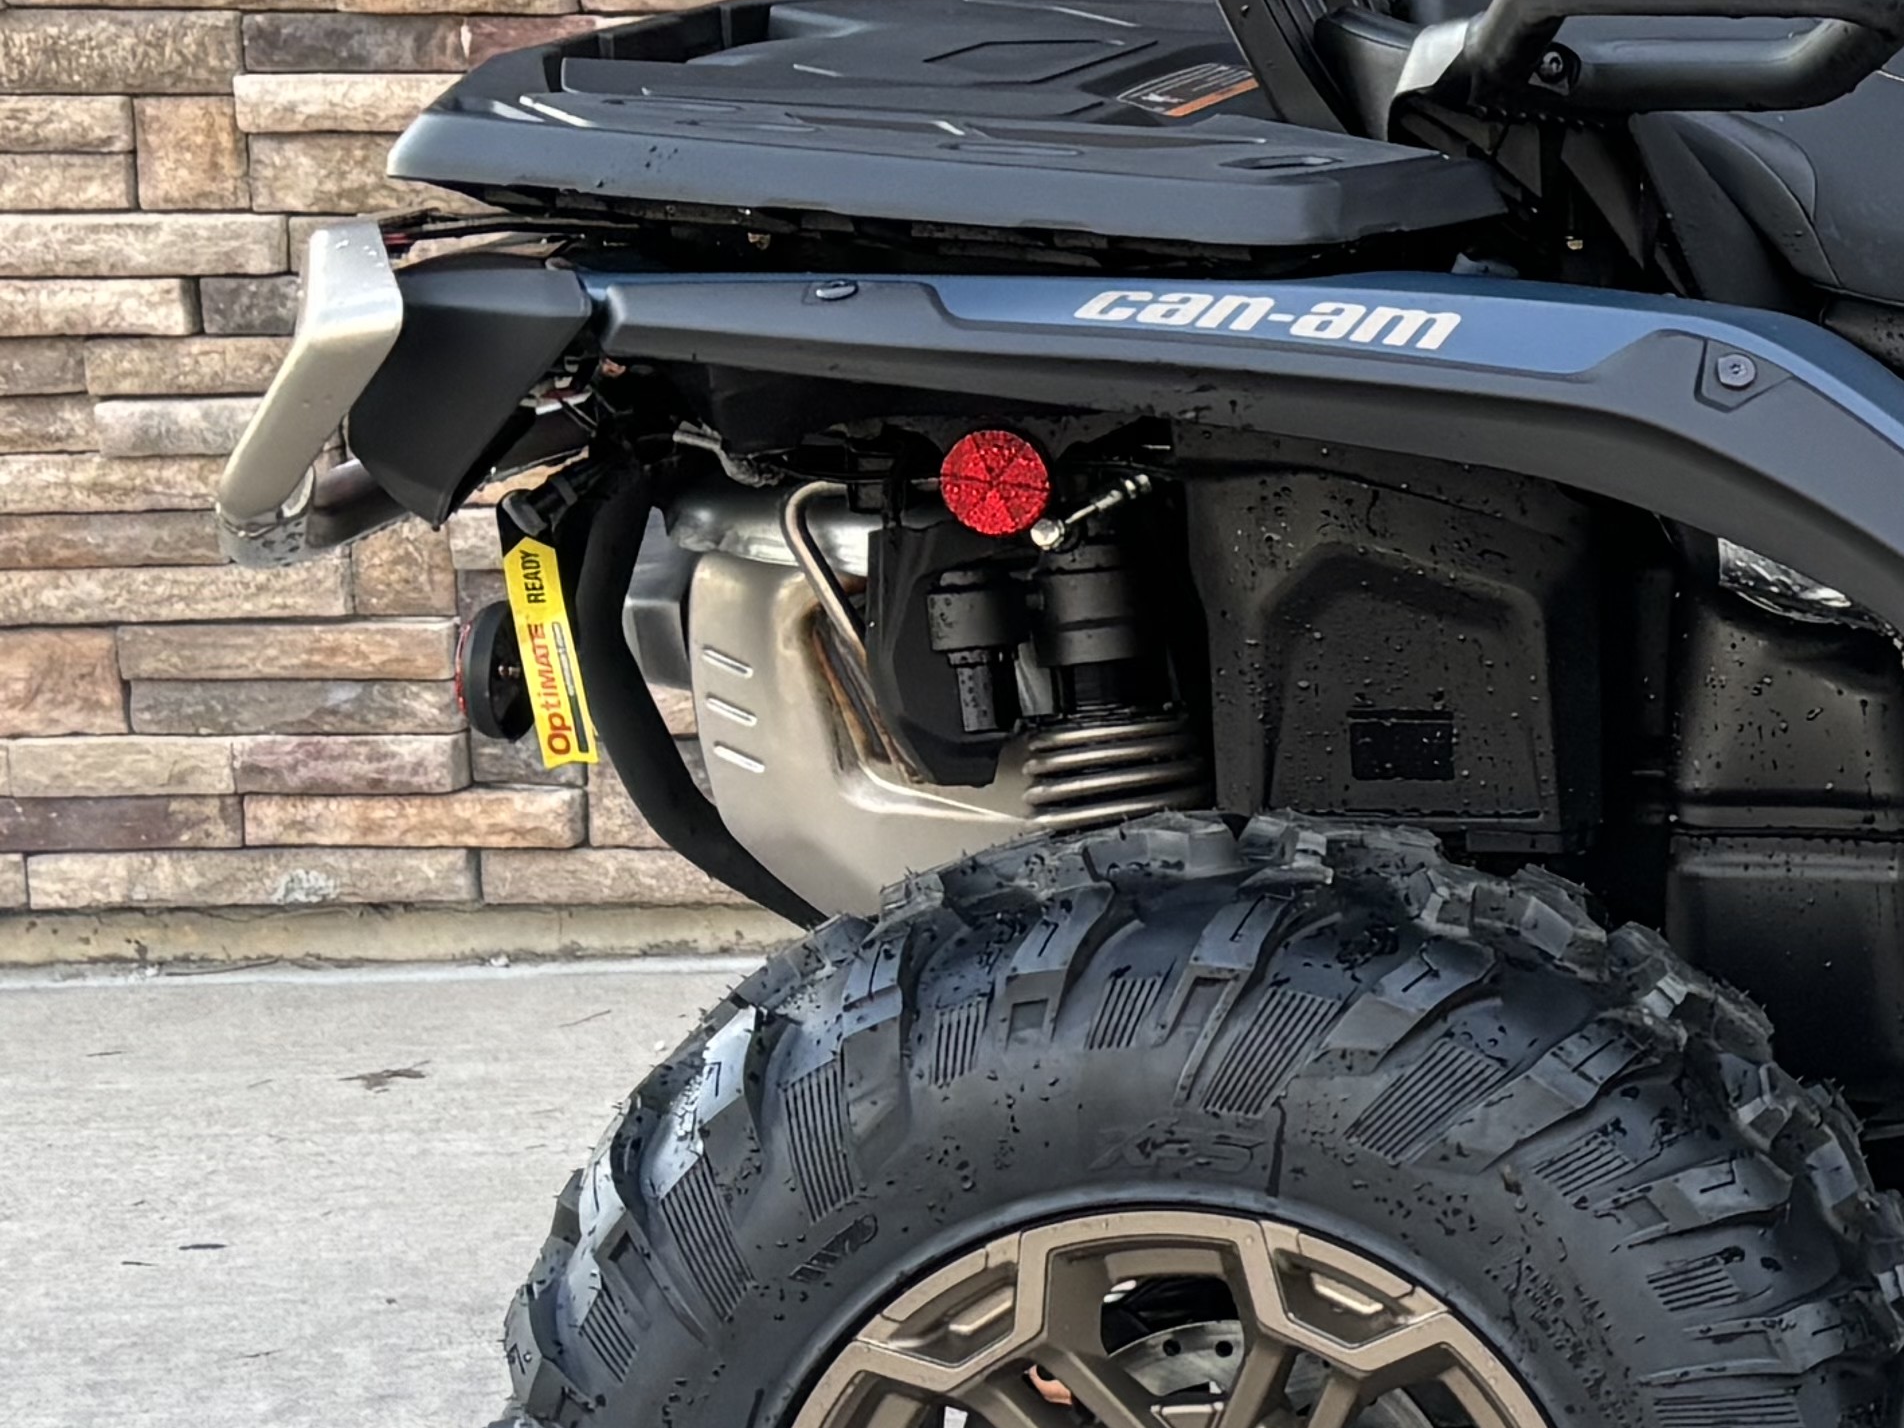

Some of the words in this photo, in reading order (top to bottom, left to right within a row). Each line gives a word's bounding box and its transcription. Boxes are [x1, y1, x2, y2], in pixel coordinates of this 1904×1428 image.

[1073, 289, 1462, 351] can-am
[518, 549, 546, 604] READY
[527, 622, 572, 756] OptiMATE
